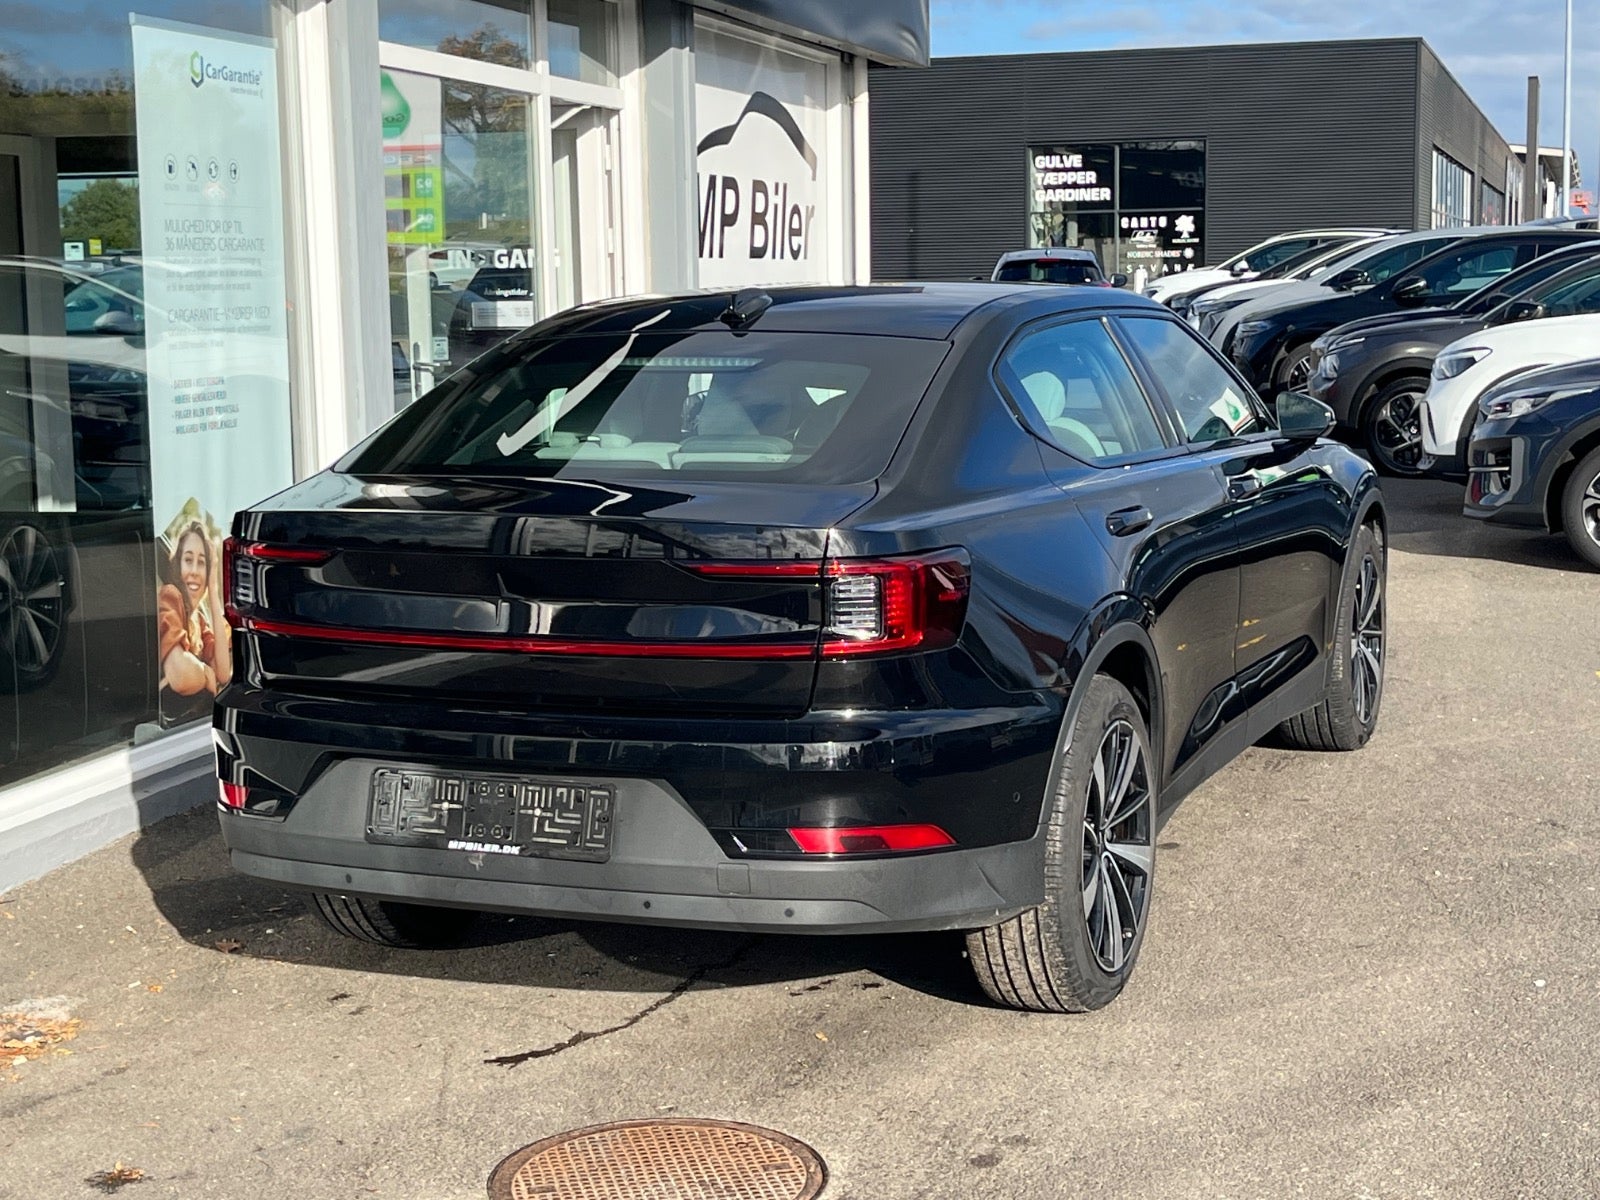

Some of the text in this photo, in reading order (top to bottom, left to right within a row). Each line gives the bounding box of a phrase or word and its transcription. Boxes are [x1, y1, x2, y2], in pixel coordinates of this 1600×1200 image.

[205, 63, 260, 86] CarGarantie
[1034, 154, 1083, 169] GULVE
[1034, 171, 1097, 186] TÆPPER
[1034, 187, 1111, 202] GARDINER
[697, 172, 816, 261] MP Biler
[164, 219, 204, 233] MULIGHED
[206, 219, 221, 233] FOR
[165, 235, 266, 252] 36 MÅNEDERS CARGARANTIE
[1126, 250, 1154, 259] NORDIC
[447, 840, 521, 855] MPBILER.DK
